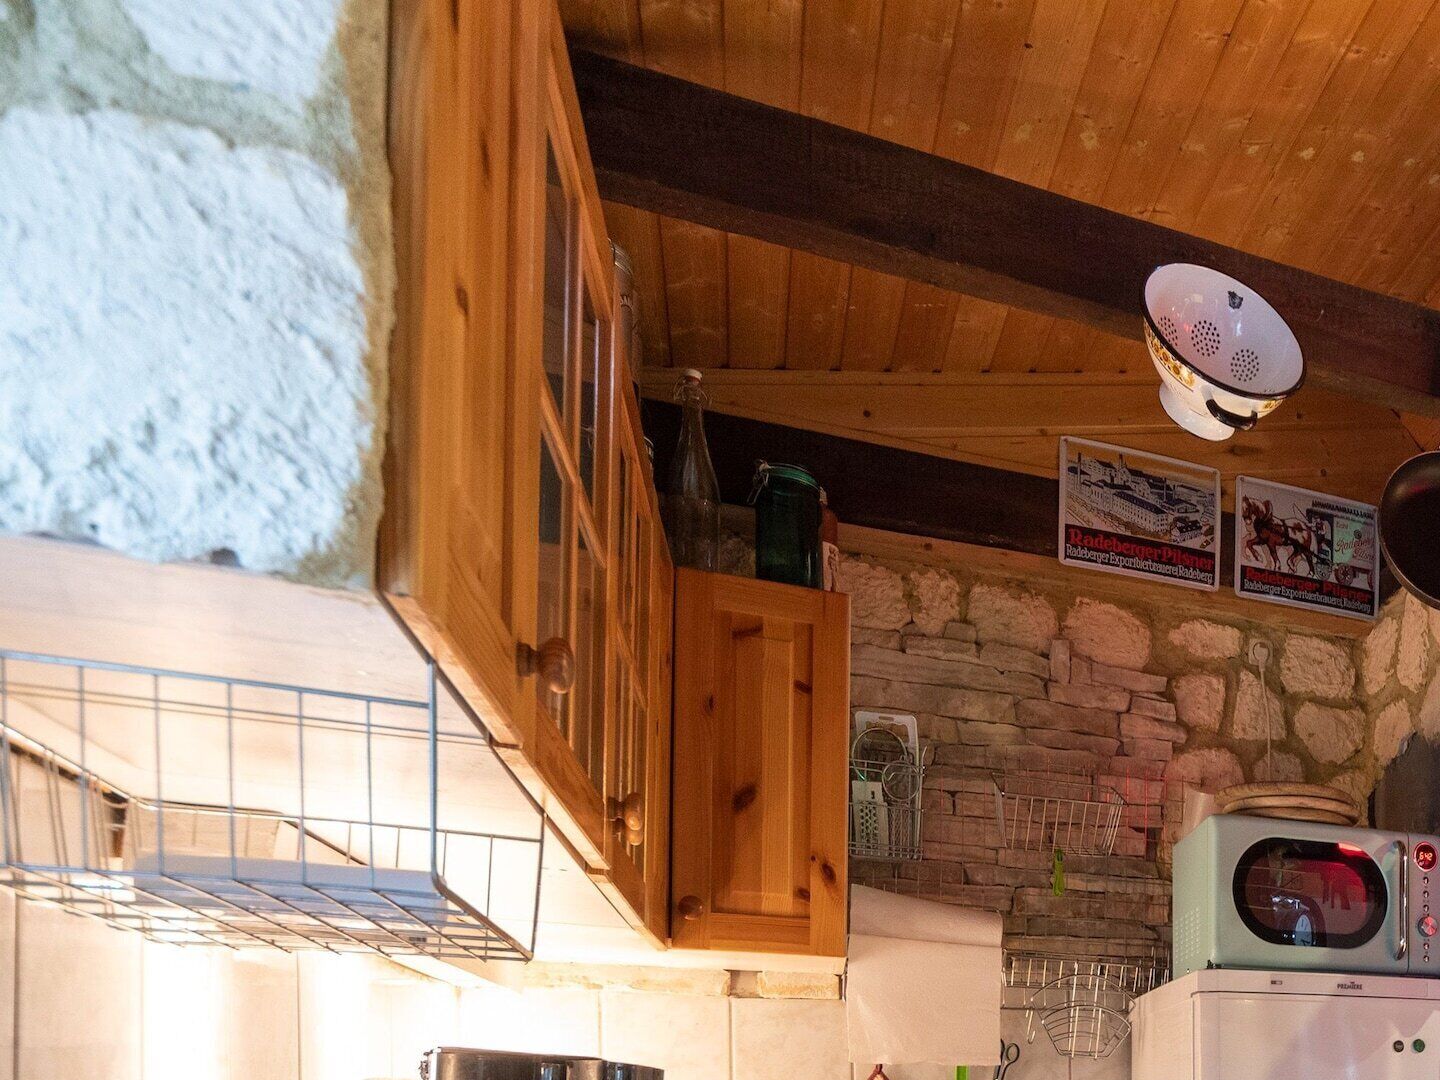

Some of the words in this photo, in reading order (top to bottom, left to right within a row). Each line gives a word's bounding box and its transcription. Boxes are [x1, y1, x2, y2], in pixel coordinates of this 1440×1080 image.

[1066, 544, 1109, 562] Radeberger
[1178, 564, 1213, 584] Radeberg
[1068, 528, 1161, 560] Radeberger
[1161, 547, 1214, 570] Pilsner
[1243, 578, 1281, 594] Radeberger
[1246, 567, 1319, 591] Radeberger
[1322, 580, 1371, 604] Pilsner
[1336, 981, 1363, 991] PREMIERE
